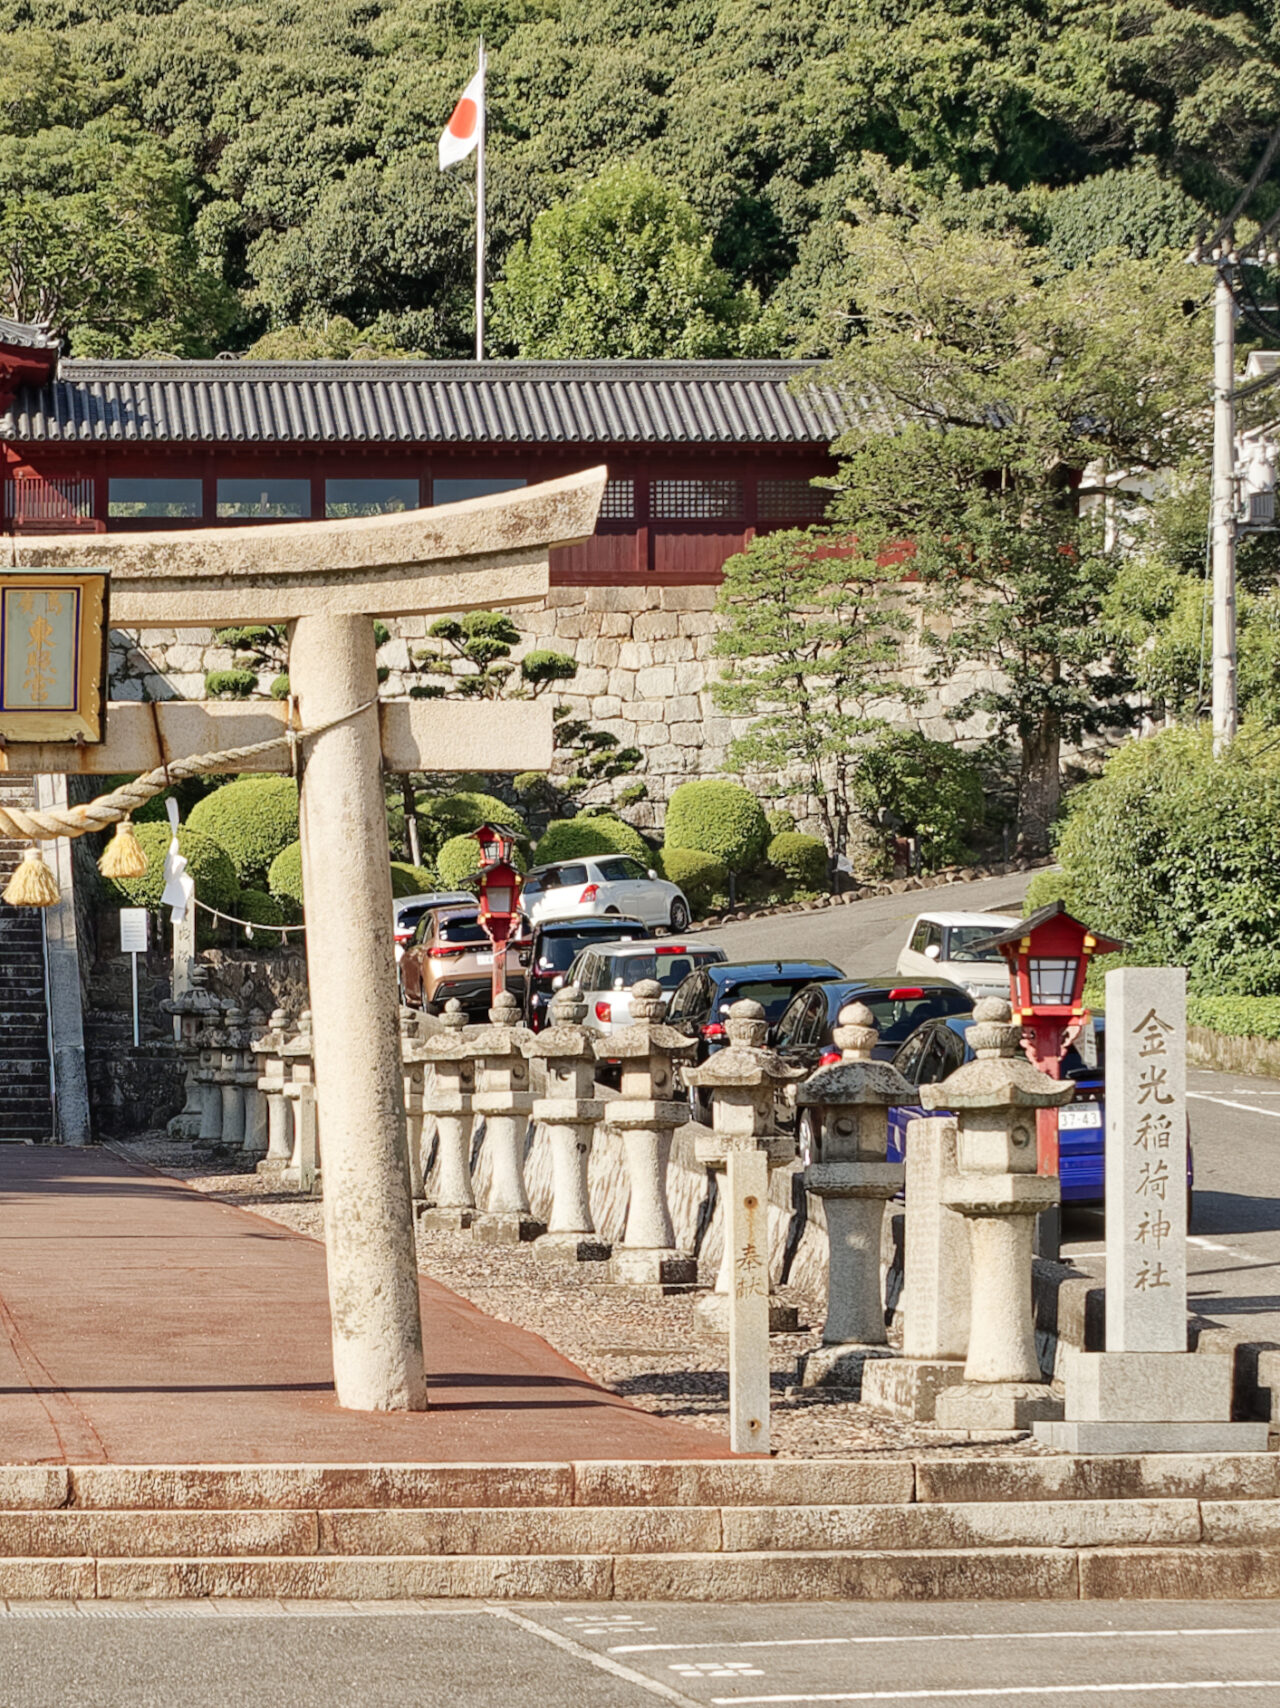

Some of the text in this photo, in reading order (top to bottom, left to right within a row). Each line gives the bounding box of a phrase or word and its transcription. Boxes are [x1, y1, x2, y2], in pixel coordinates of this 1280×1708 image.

[1131, 1006, 1176, 1292] 金光稲荷神社
